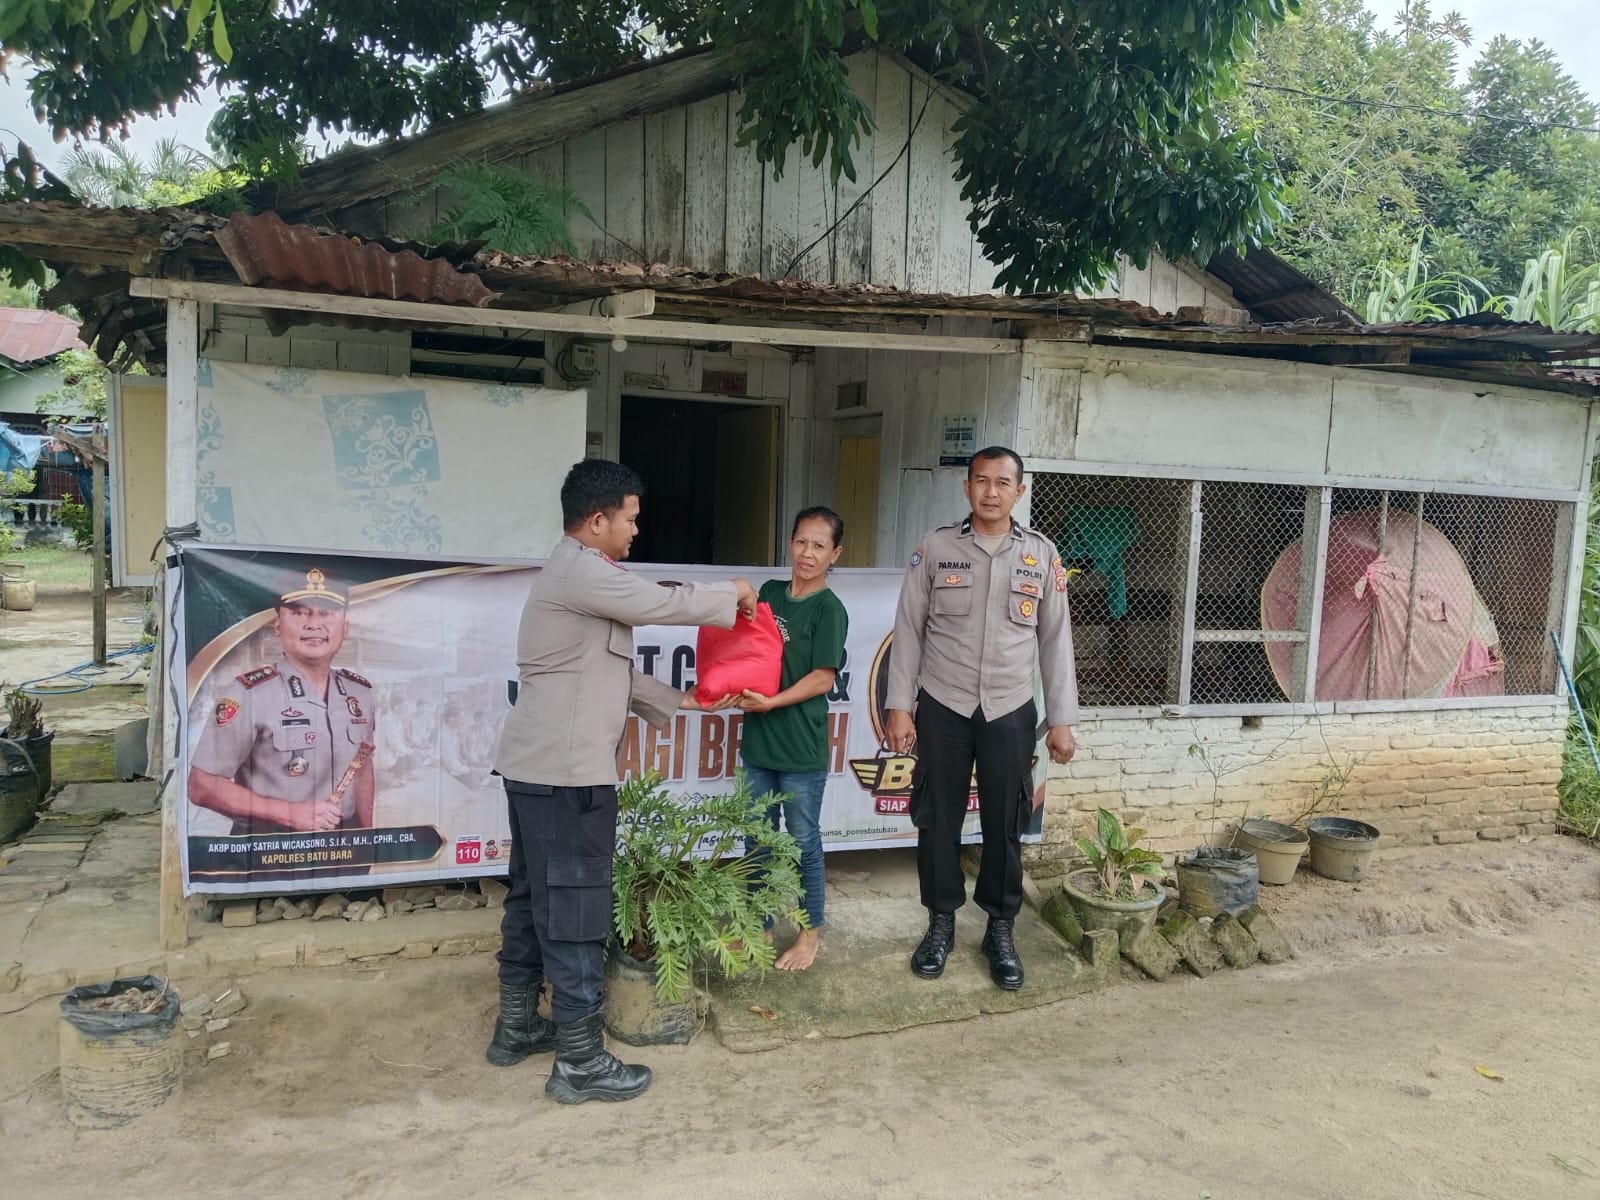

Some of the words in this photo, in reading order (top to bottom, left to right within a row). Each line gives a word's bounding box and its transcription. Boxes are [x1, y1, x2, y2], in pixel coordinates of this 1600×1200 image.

[938, 561, 971, 571] PARMAN
[1016, 568, 1042, 580] POLRI
[880, 799, 907, 812] SIAP
[208, 842, 229, 853] AKBP
[231, 842, 251, 853] DONY
[253, 840, 280, 851] SATRIA
[261, 853, 305, 865] KAPOLRES
[307, 851, 328, 862] BATU
[330, 850, 353, 861] BARA
[457, 848, 479, 860] 110
